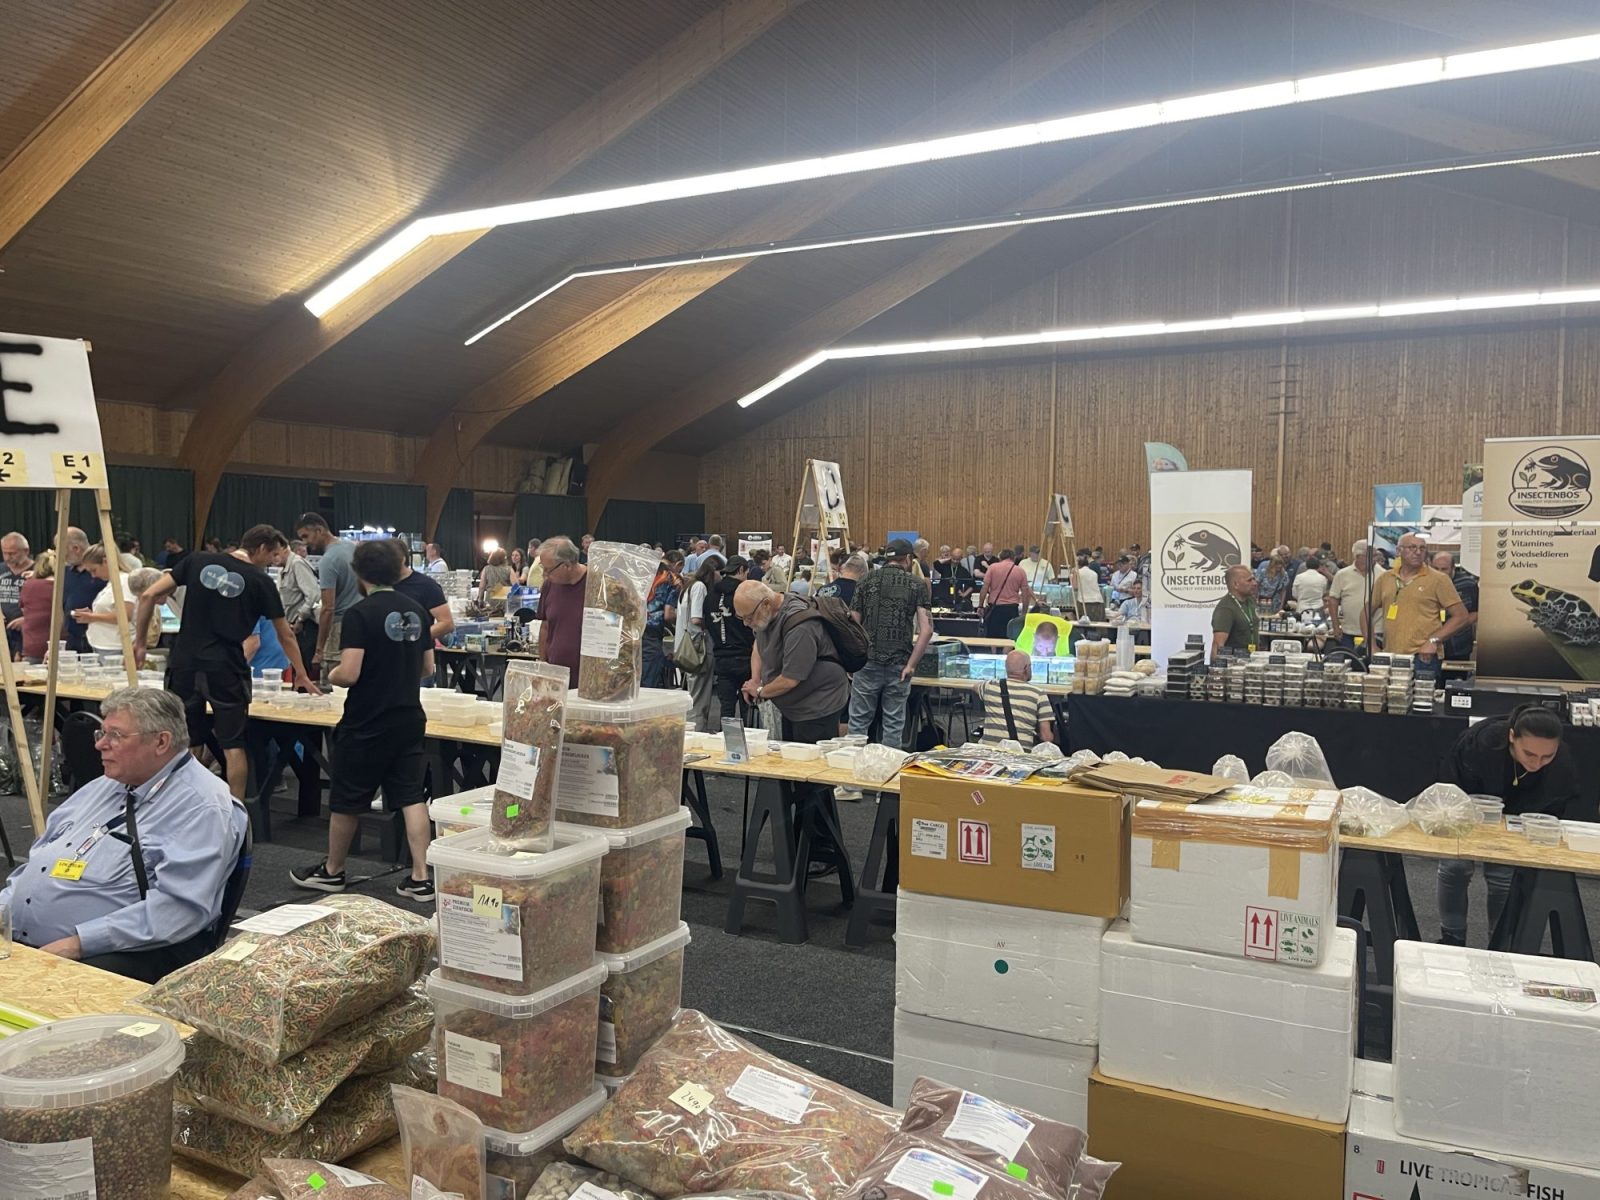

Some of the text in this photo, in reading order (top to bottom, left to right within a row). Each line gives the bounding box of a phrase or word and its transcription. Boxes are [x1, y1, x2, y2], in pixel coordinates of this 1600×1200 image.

[0, 343, 59, 434] E
[1517, 491, 1580, 499] INSECTENBOS
[1511, 528, 1597, 538] Inrichtingteriaal
[1511, 550, 1569, 558] Voedseldieren
[1166, 575, 1227, 585] INSECTENBO
[1353, 1145, 1360, 1153] 8
[1400, 1160, 1434, 1180] LIVE
[1526, 1183, 1565, 1200] FISH
